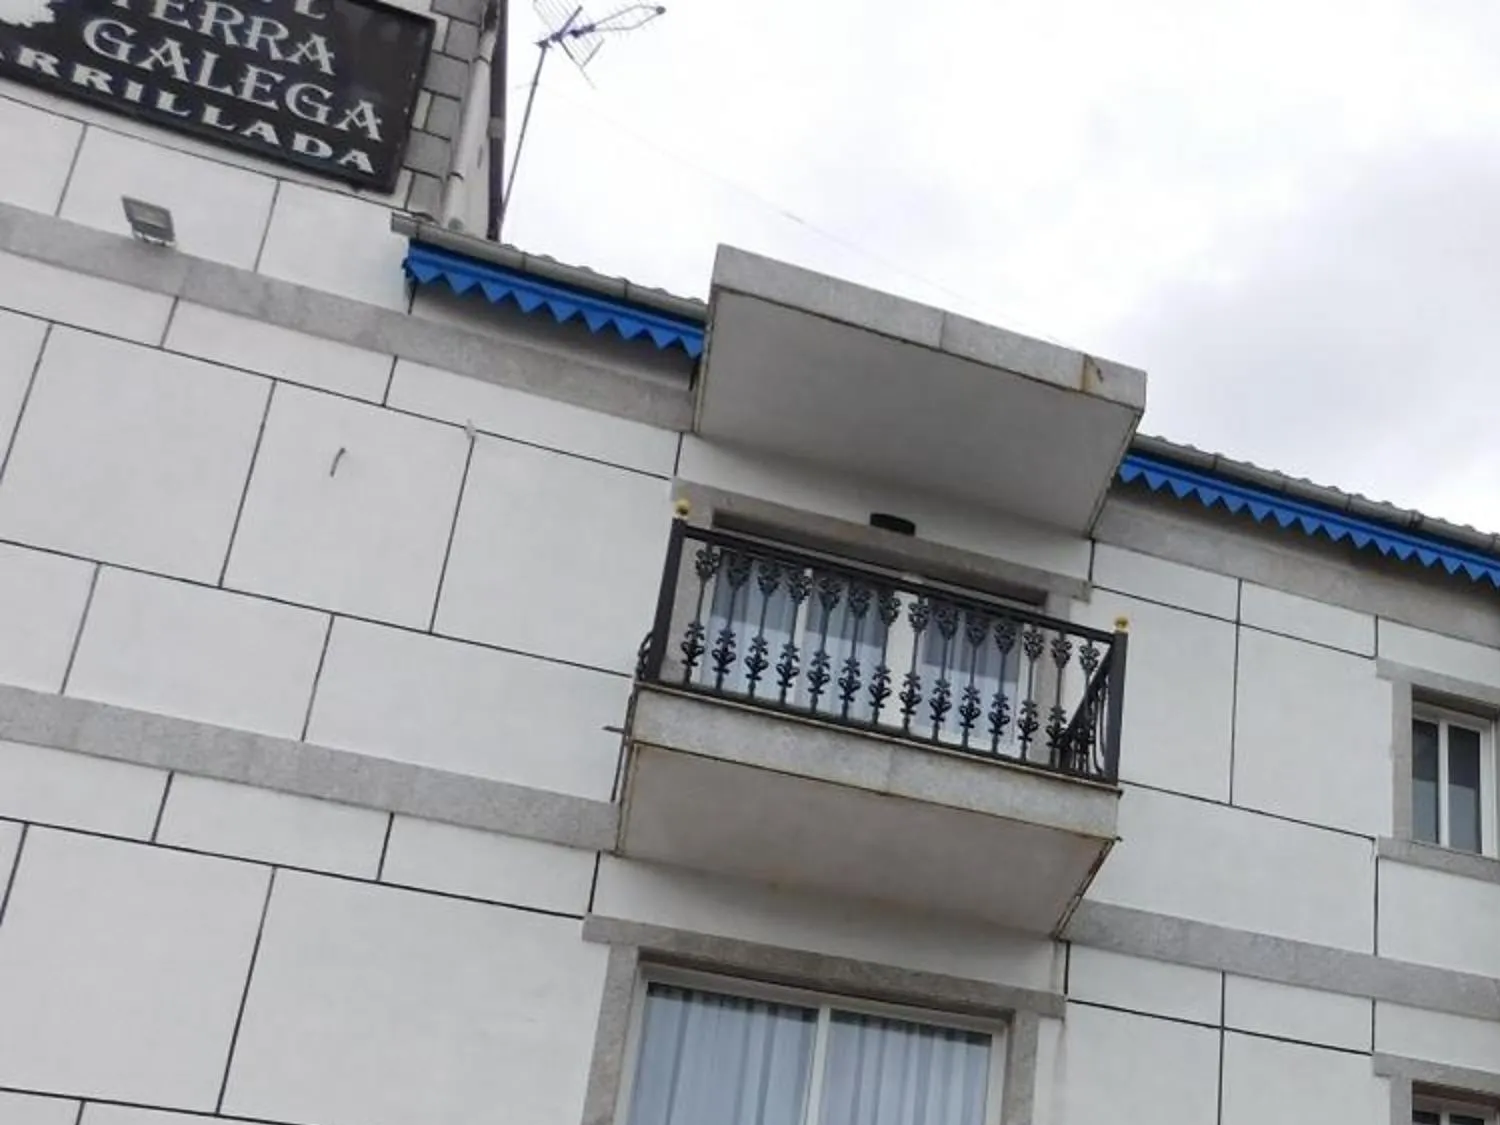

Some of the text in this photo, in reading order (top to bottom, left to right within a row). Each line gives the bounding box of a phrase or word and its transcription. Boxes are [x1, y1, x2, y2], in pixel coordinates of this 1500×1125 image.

[83, 18, 383, 142] GALEGA
[111, 0, 336, 76] ERRA
[0, 45, 376, 175] RRILLADA
